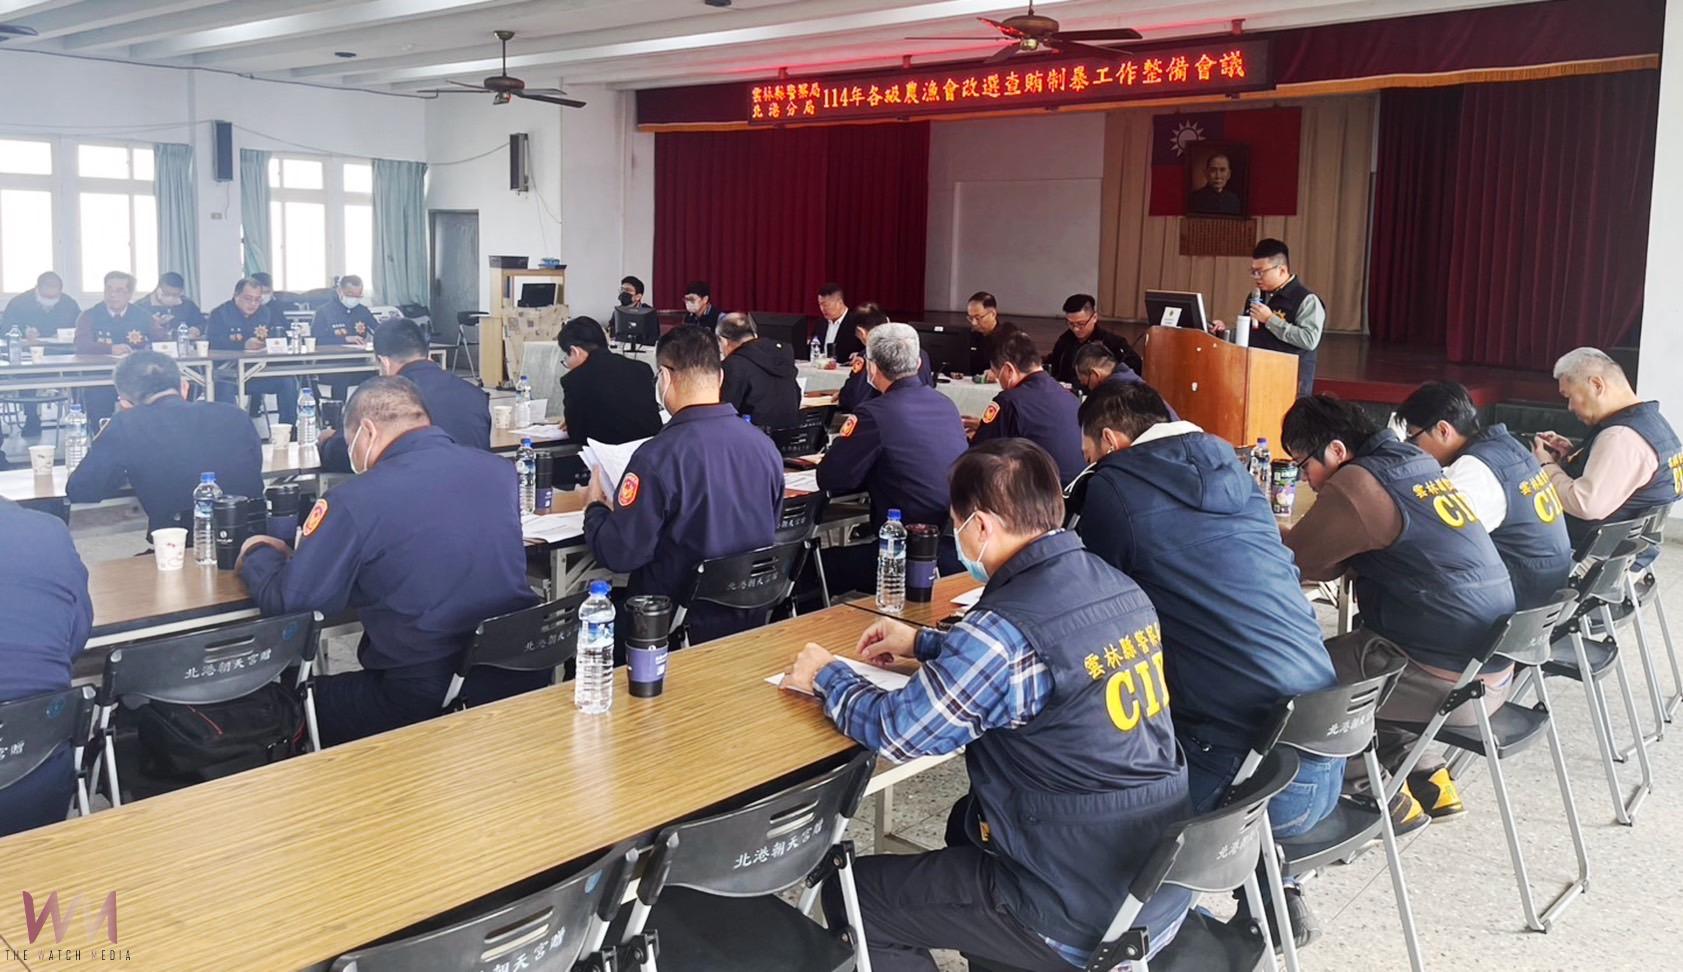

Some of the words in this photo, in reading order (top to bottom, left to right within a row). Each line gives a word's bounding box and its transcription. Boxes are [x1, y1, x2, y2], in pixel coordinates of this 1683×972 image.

[752, 82, 821, 102] 雲林縣警察局
[752, 99, 816, 118] 北港分局
